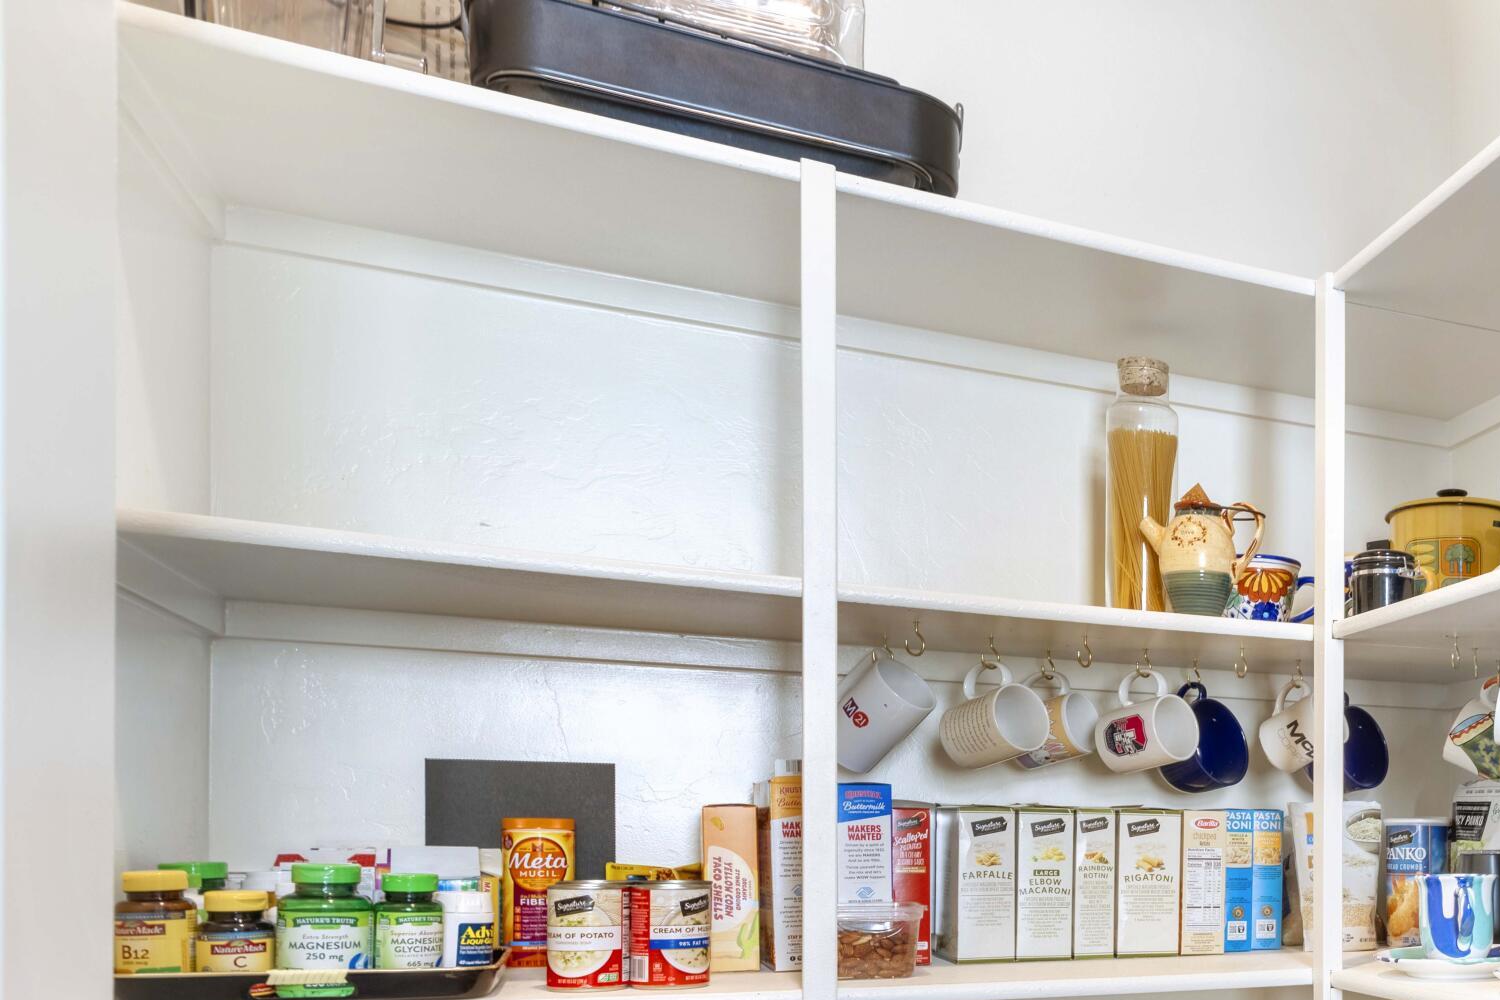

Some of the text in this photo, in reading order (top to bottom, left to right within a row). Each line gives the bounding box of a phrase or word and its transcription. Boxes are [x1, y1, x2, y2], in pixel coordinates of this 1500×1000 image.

[842, 800, 886, 812] Buttermilk
[847, 825, 881, 833] MAKERS
[848, 833, 882, 841] WANTED
[509, 852, 568, 869] Meta
[520, 870, 557, 878] MUCIL
[962, 870, 1013, 880] FARFALLE
[1125, 874, 1174, 883] RIGATONI
[1029, 878, 1062, 886] ELBOW
[712, 856, 723, 921] TACO SHELLS
[723, 862, 734, 918] YELLOW CORN
[1019, 887, 1071, 896] MACARONI
[520, 898, 547, 906] FIBE
[296, 917, 330, 925] NATURE'S
[462, 926, 494, 939] Advi
[288, 940, 361, 950] MAGNESIUM
[122, 945, 149, 960] B12
[233, 956, 247, 968] C
[305, 953, 344, 963] 250 mg
